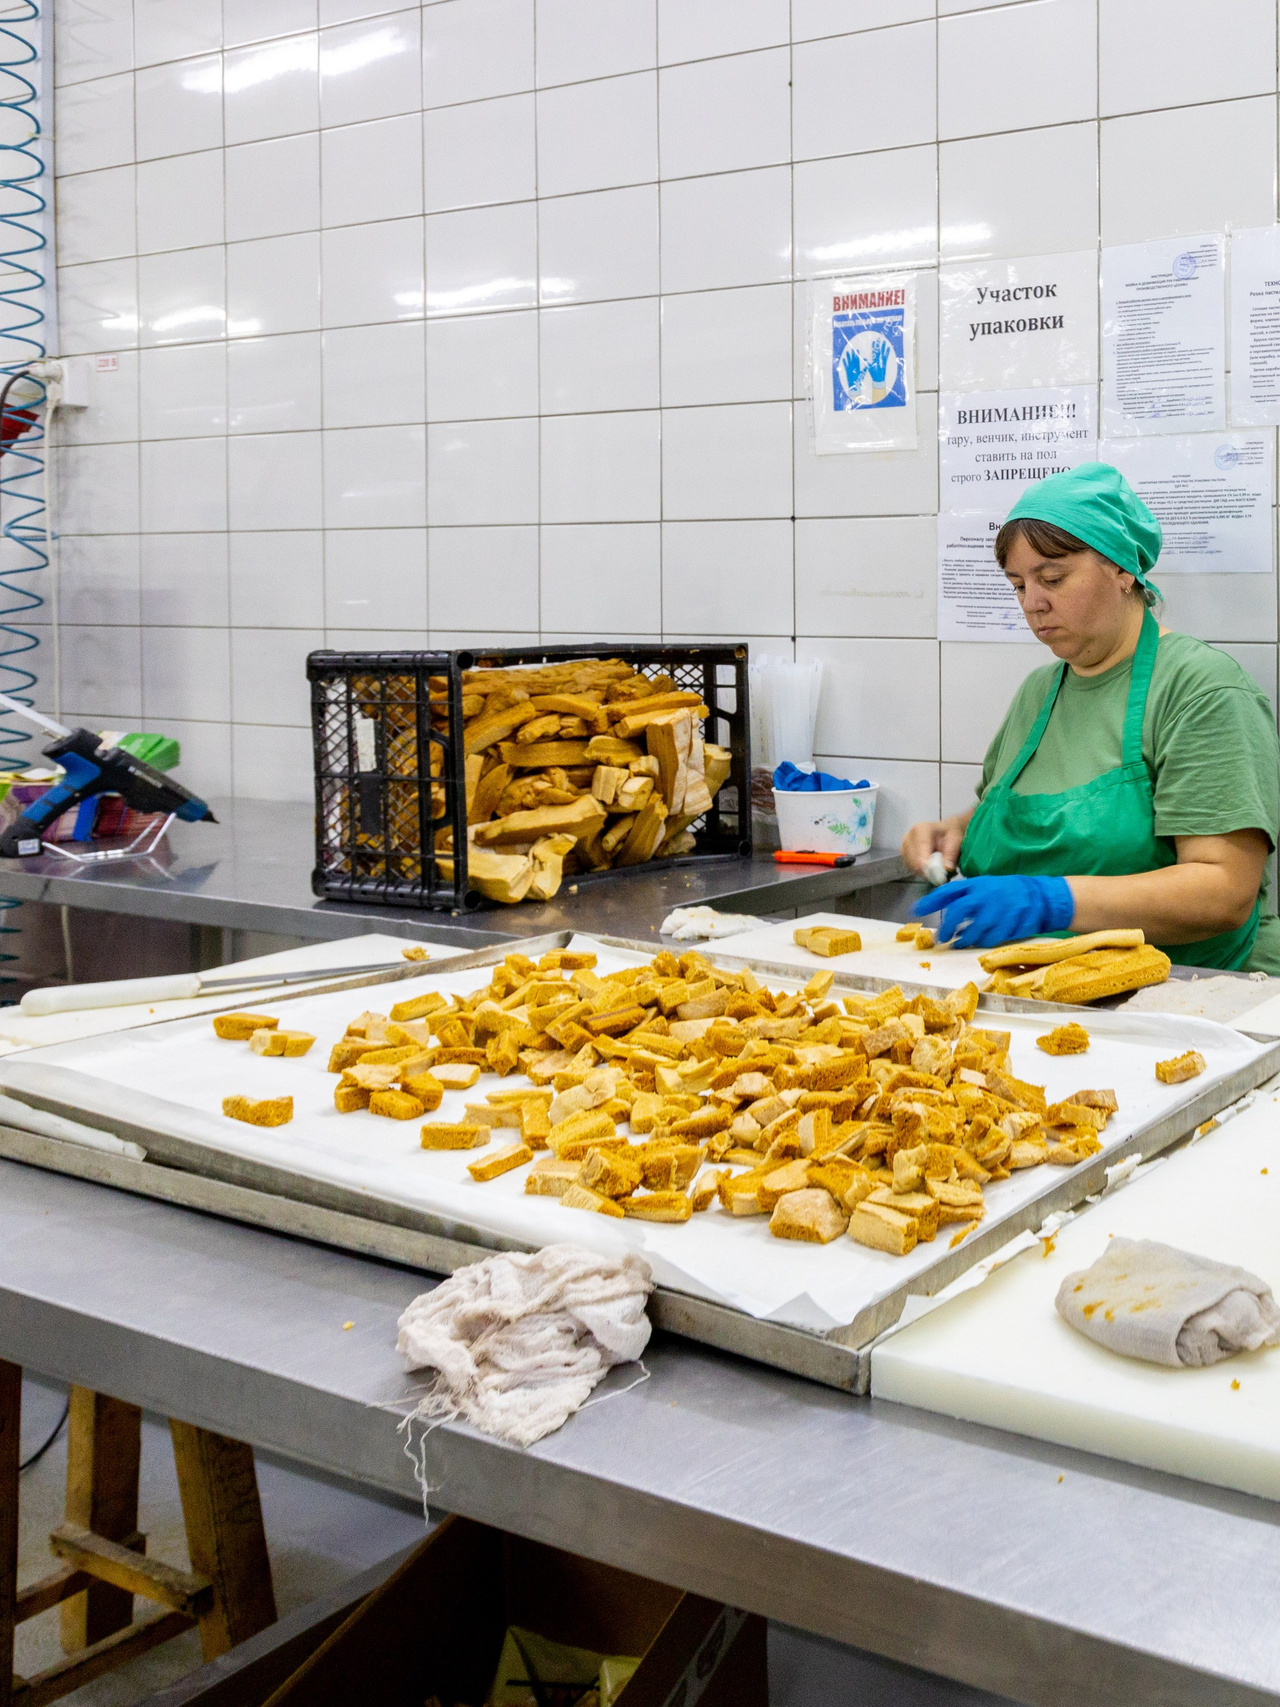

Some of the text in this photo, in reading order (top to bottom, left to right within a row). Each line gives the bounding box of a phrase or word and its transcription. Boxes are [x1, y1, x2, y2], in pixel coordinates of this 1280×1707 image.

[833, 289, 905, 312] ВНИМАНИЕ!
[976, 283, 1057, 305] Участок
[969, 314, 1064, 341] упаковки
[958, 404, 1076, 425] ВНИМАНИЕ!!!
[976, 432, 1018, 446] венчик,
[975, 449, 1057, 462] ставить на пол
[951, 474, 981, 485] строго
